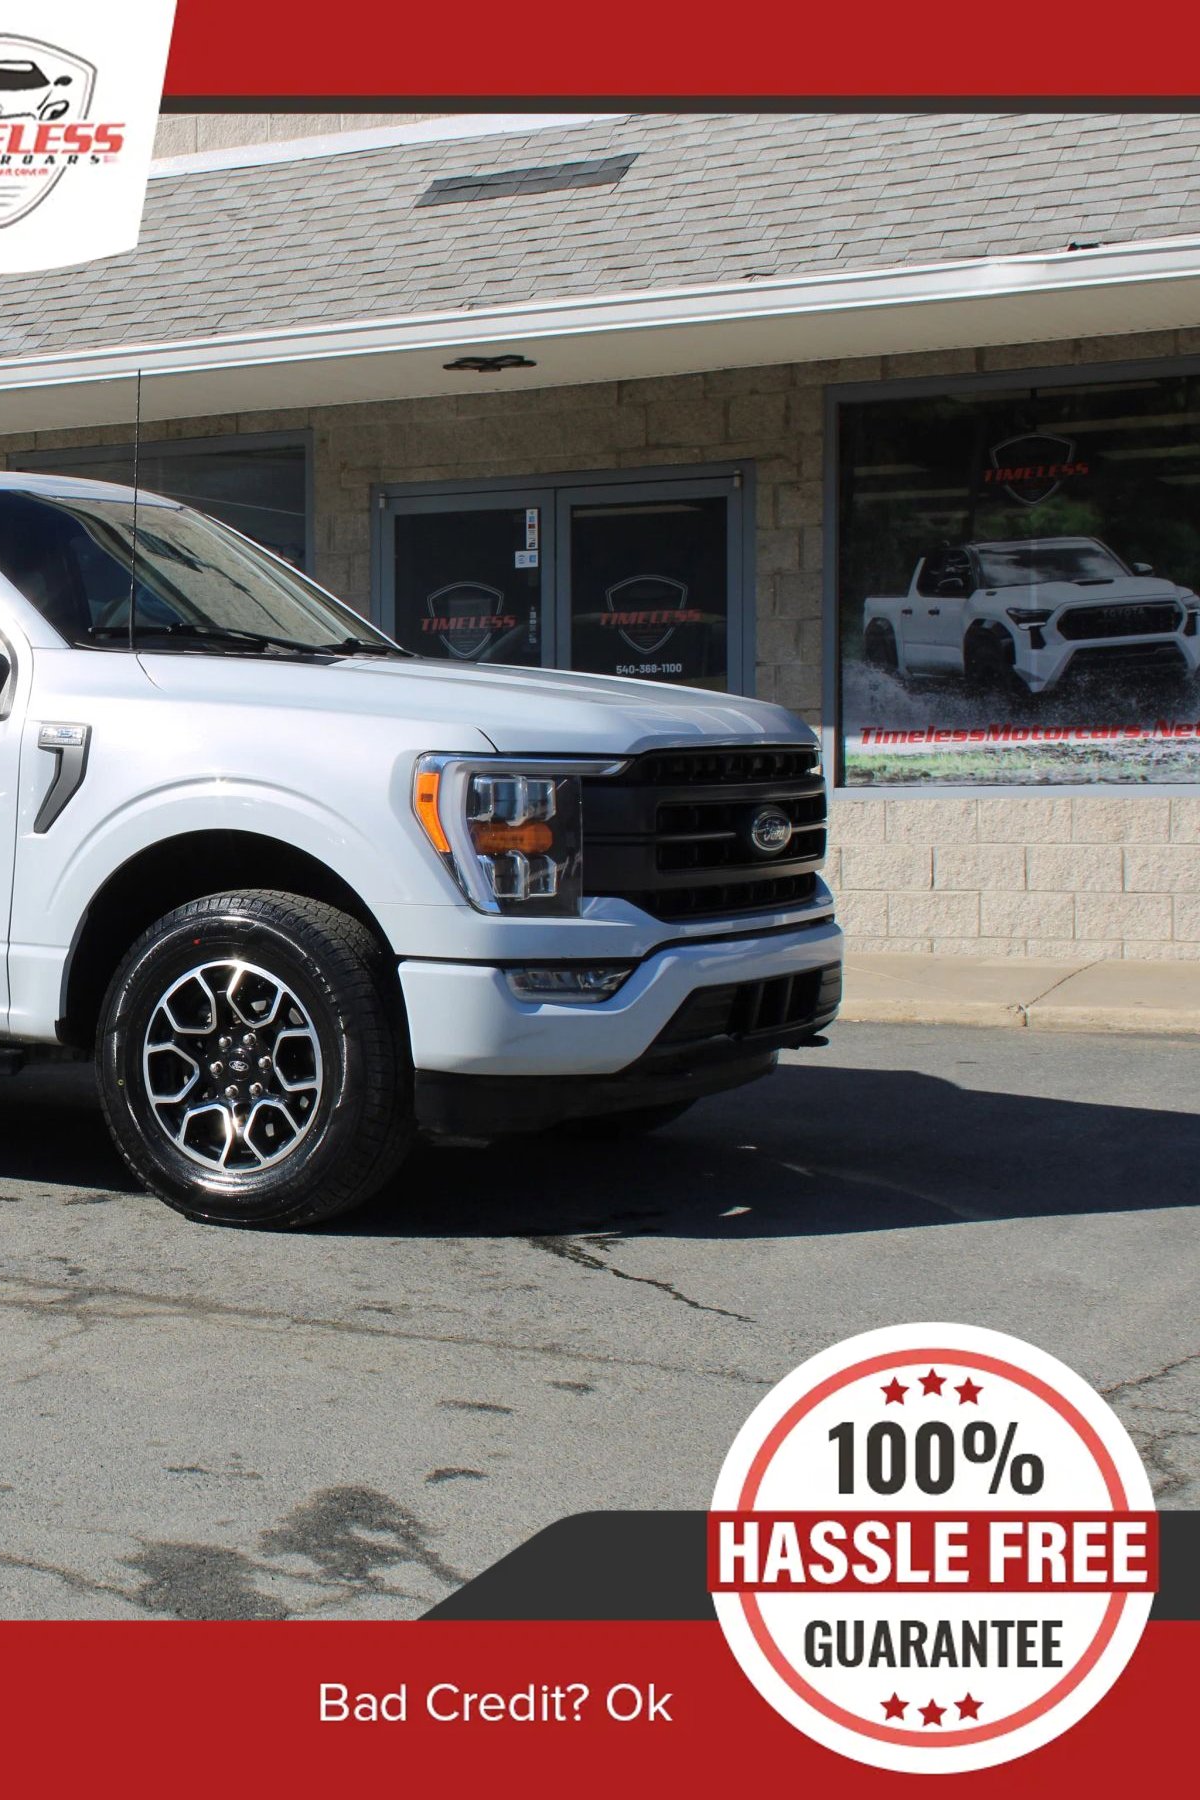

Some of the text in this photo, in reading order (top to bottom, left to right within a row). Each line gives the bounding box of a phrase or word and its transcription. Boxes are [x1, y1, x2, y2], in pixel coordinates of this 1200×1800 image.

[983, 461, 1088, 484] TIMELESS
[420, 614, 518, 632] TIMELESS
[599, 608, 704, 627] TIMELESS
[615, 662, 683, 676] 540-368-1100
